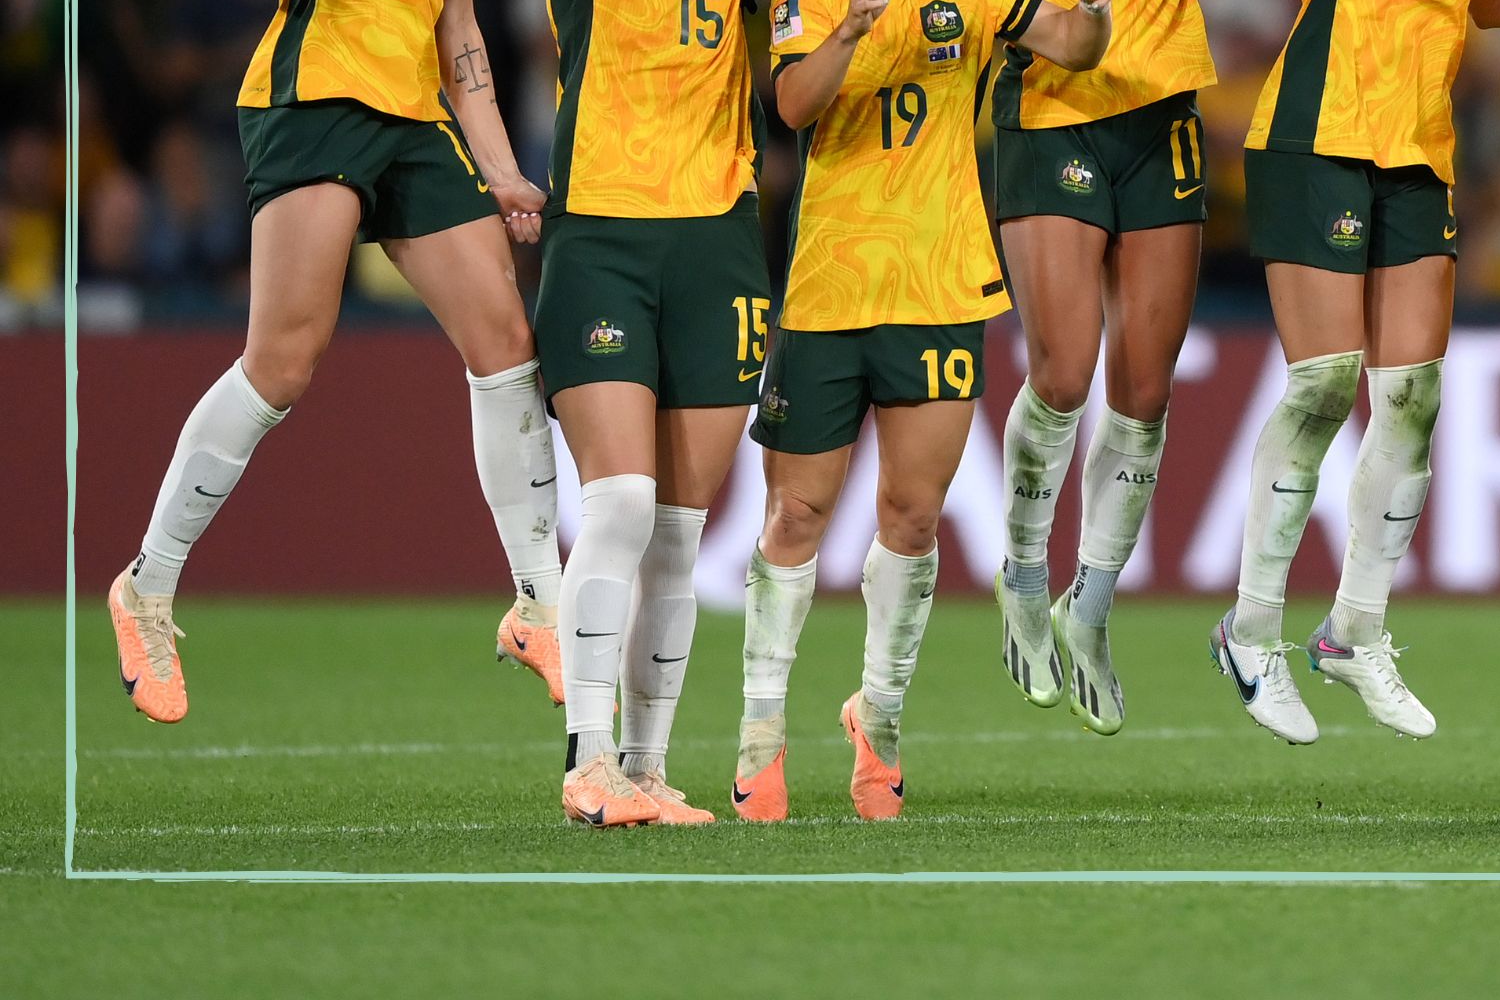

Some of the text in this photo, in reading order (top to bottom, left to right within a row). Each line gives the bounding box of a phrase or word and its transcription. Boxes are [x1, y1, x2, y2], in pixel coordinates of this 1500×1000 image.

[874, 82, 928, 150] 19
[1169, 116, 1202, 180] 11
[731, 296, 771, 363] 15
[919, 348, 974, 399] 19
[1014, 486, 1052, 500] AUS
[1116, 470, 1156, 484] AUS
